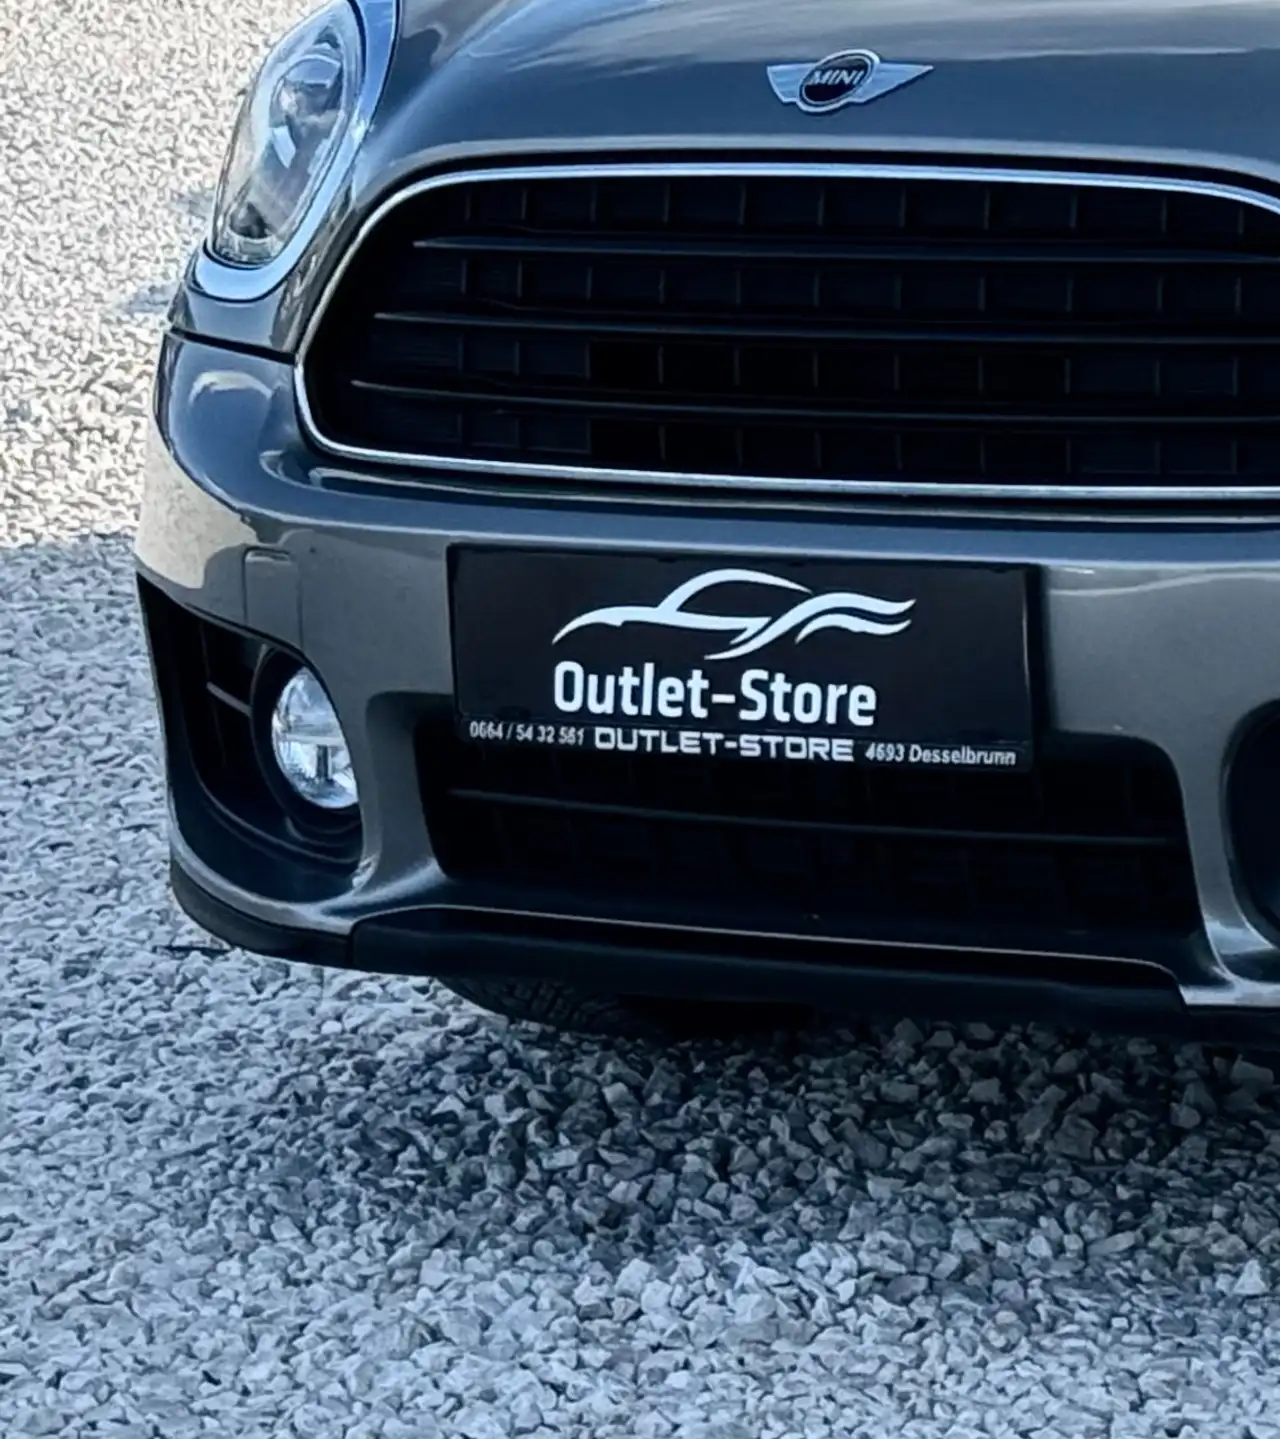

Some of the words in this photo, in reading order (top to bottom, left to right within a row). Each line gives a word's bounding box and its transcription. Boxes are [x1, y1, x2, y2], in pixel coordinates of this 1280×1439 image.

[810, 69, 865, 85] MINI
[553, 660, 877, 727] Outlet-Store
[516, 724, 534, 741] 54
[594, 726, 856, 762] OUTLET-STORE
[909, 743, 1017, 766] Desselbrunn
